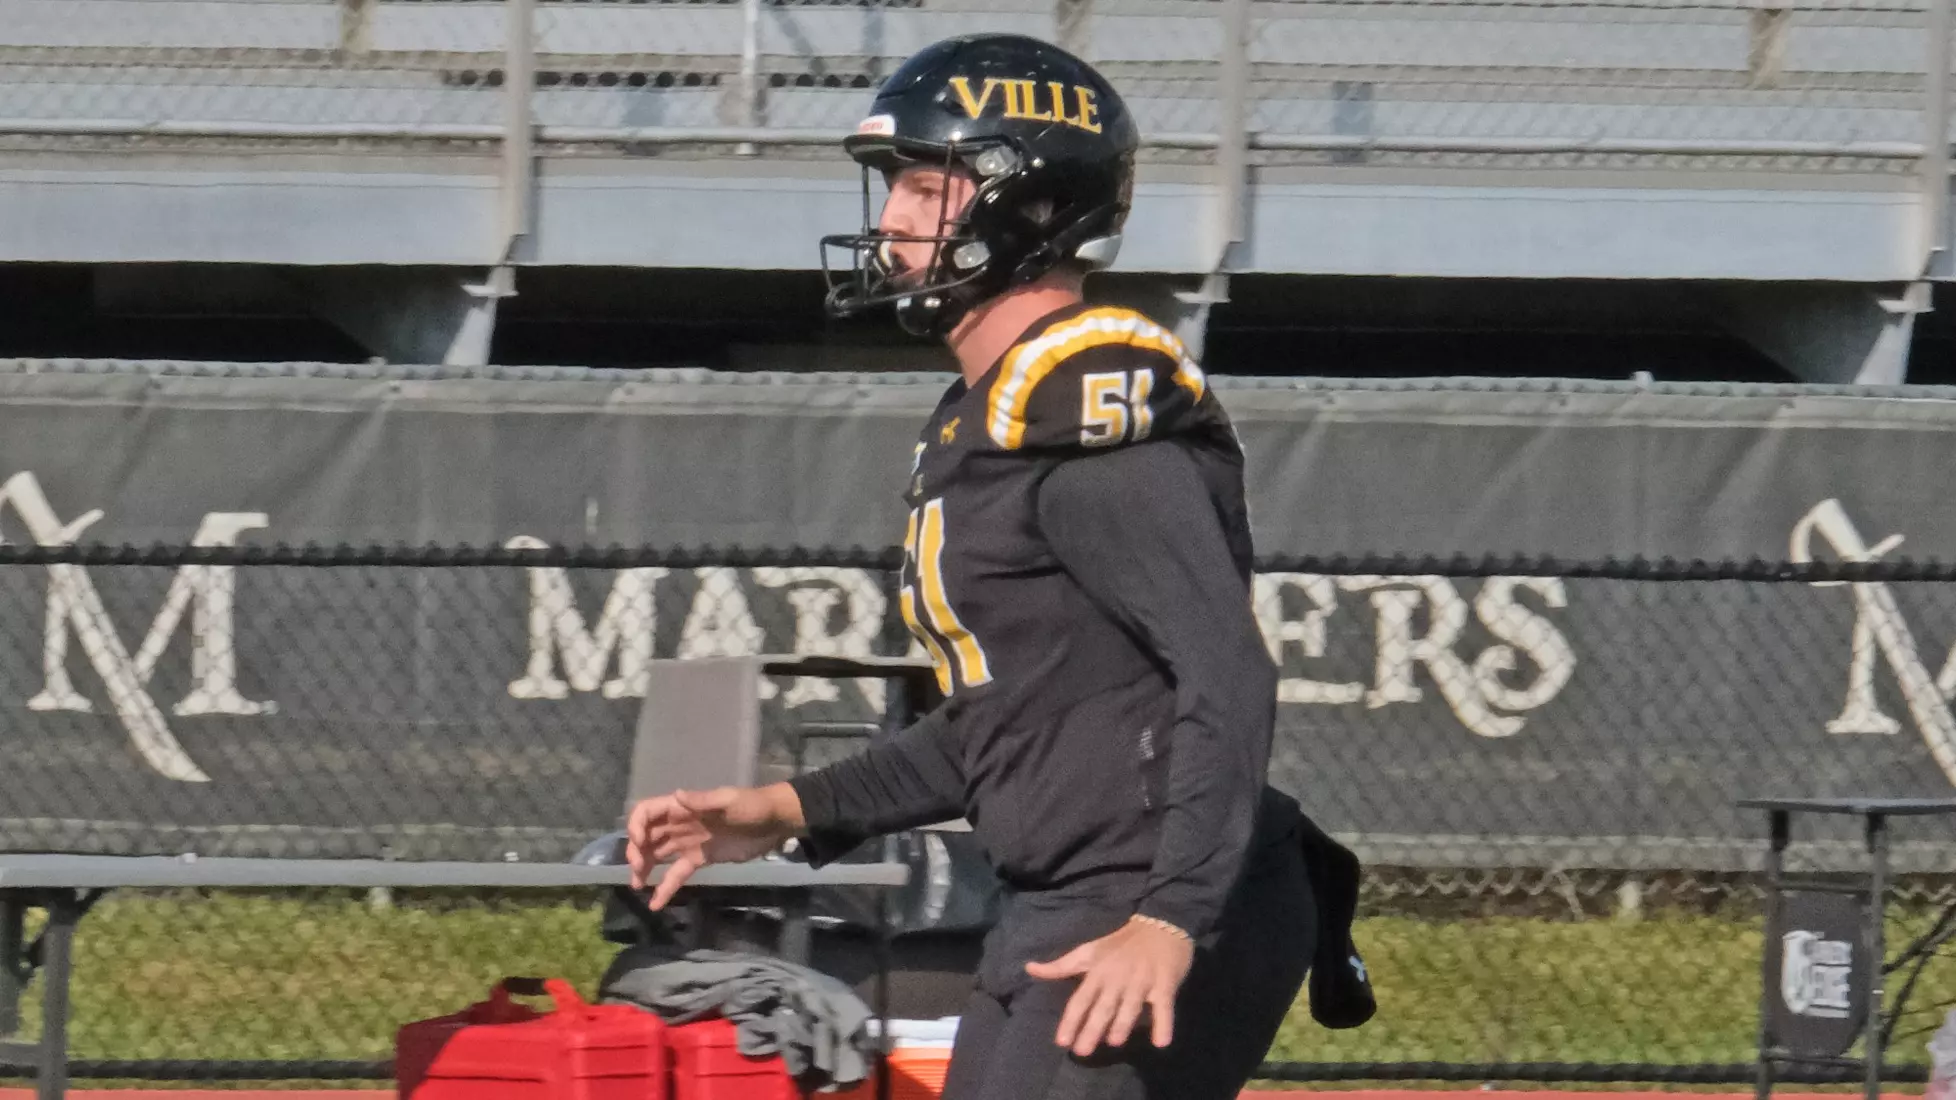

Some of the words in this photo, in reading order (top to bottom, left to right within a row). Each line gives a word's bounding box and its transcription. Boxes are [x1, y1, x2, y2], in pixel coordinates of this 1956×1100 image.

[948, 76, 1102, 134] VILLE
[1080, 368, 1154, 447] 51
[504, 535, 1577, 738] MARERS
